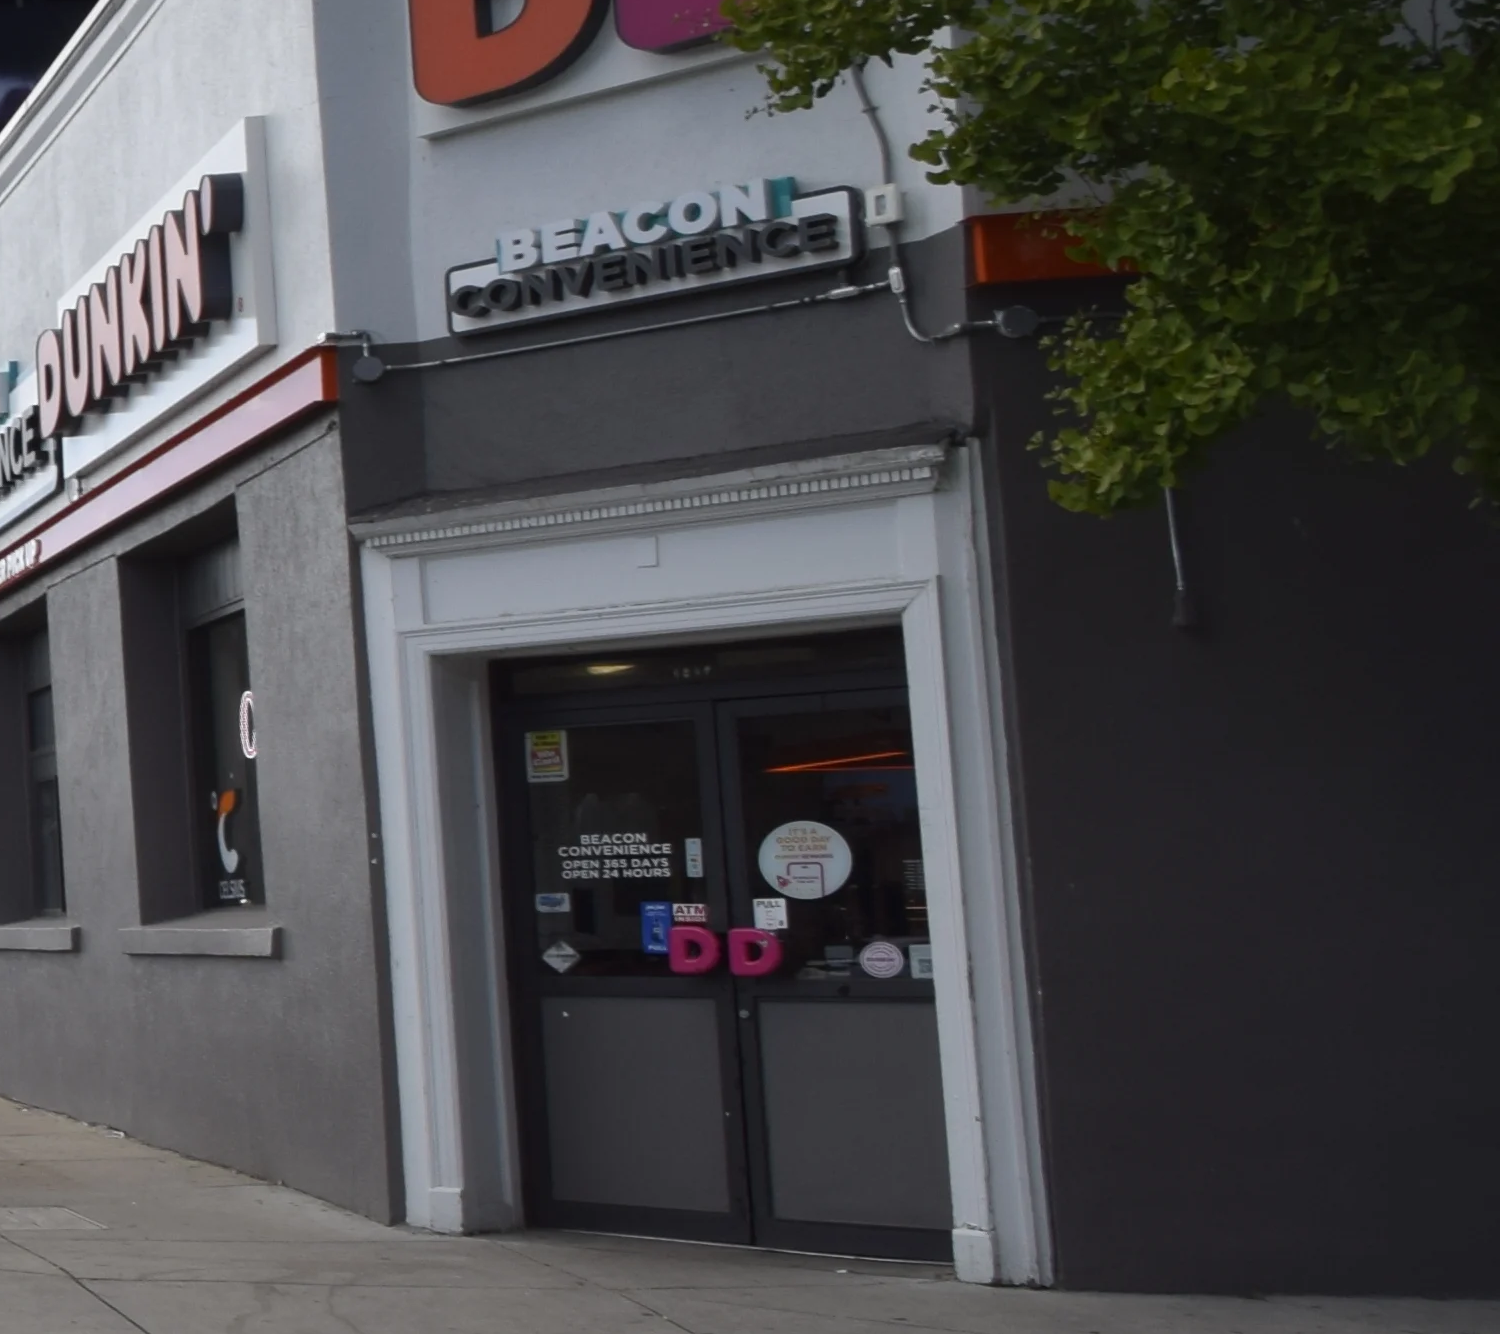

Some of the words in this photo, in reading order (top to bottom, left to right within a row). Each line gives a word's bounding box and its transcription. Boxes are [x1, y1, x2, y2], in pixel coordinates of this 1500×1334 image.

[498, 177, 775, 272] BEACON
[451, 214, 839, 317] CONVENIENCE
[36, 174, 222, 440] DUNKIN'
[580, 833, 647, 845] BEACON
[776, 836, 807, 844] GOOD
[811, 835, 832, 843] DAY
[558, 843, 672, 857] CONVENIENCE
[562, 860, 600, 870] OPEN
[603, 859, 627, 868] 365
[631, 858, 668, 867] DAYS
[561, 870, 600, 879] OPEN
[602, 869, 619, 879] 24
[623, 868, 671, 878] HOURS
[675, 904, 706, 915] ATM
